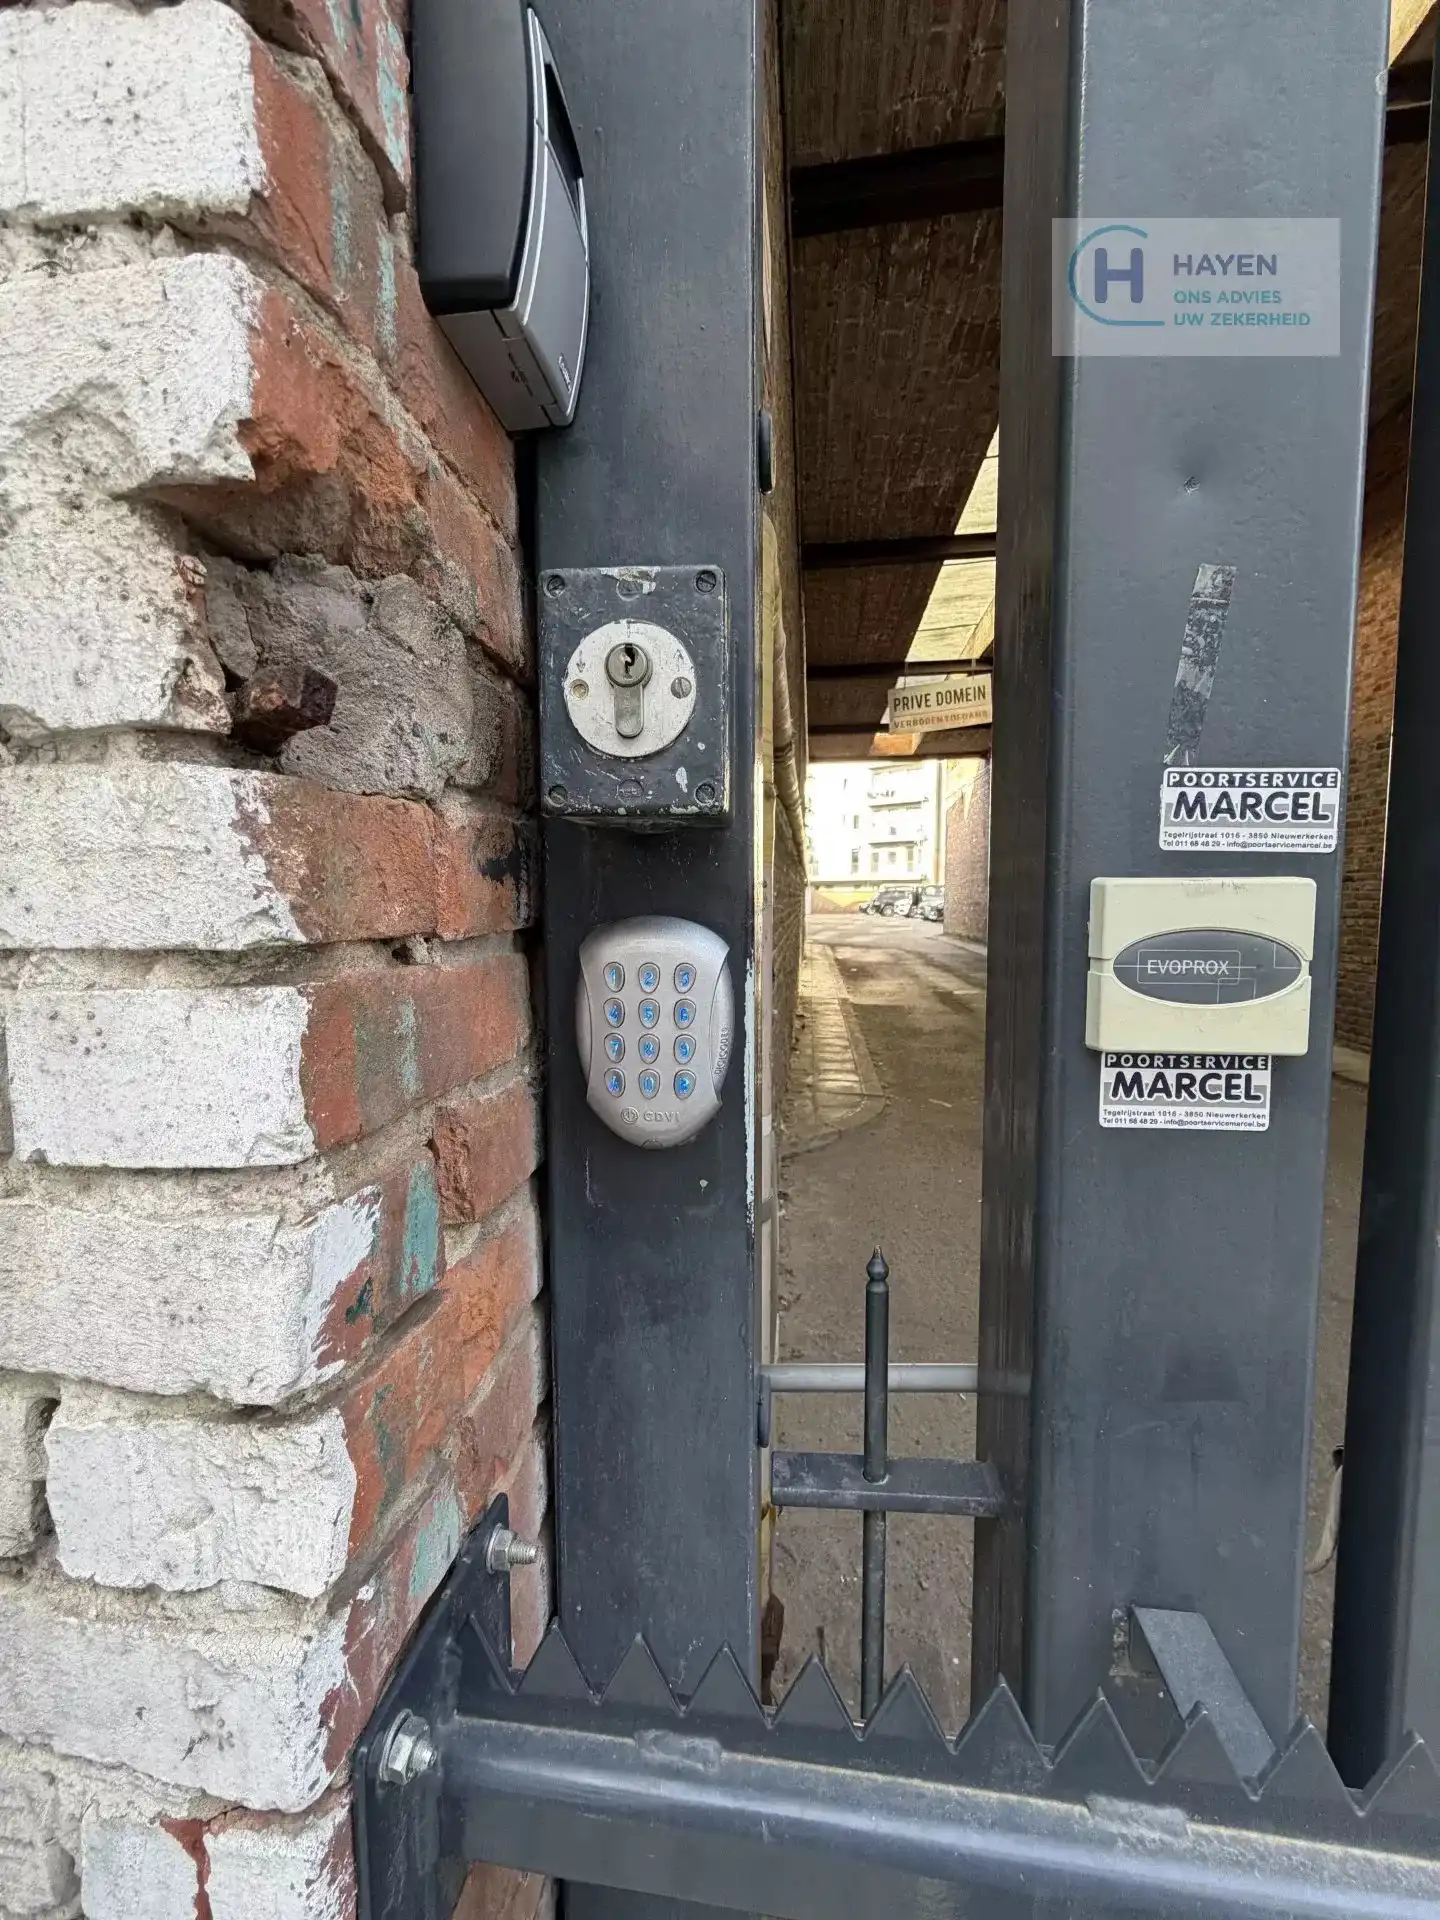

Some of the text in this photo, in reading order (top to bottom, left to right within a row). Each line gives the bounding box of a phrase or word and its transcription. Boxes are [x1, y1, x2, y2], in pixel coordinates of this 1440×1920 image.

[893, 685, 987, 712] PRIVE DOMEIN
[1169, 773, 1336, 787] POORTSERVICE
[1172, 791, 1330, 821] MARCEL
[1163, 831, 1218, 840] Tegelrijstraat
[1271, 832, 1334, 840] Nieuwerkerken
[1147, 959, 1230, 975] EVOPROX
[609, 969, 690, 987] 1 2 3
[609, 1005, 619, 1020] 4
[643, 1006, 654, 1020] 5
[610, 1040, 620, 1056] 7
[680, 1041, 690, 1058] 9
[1107, 1054, 1266, 1069] POORTSERVICE
[643, 1076, 654, 1092] 0
[1111, 1071, 1262, 1101] MARCEL
[1206, 1111, 1266, 1119] Nieuwerkerken
